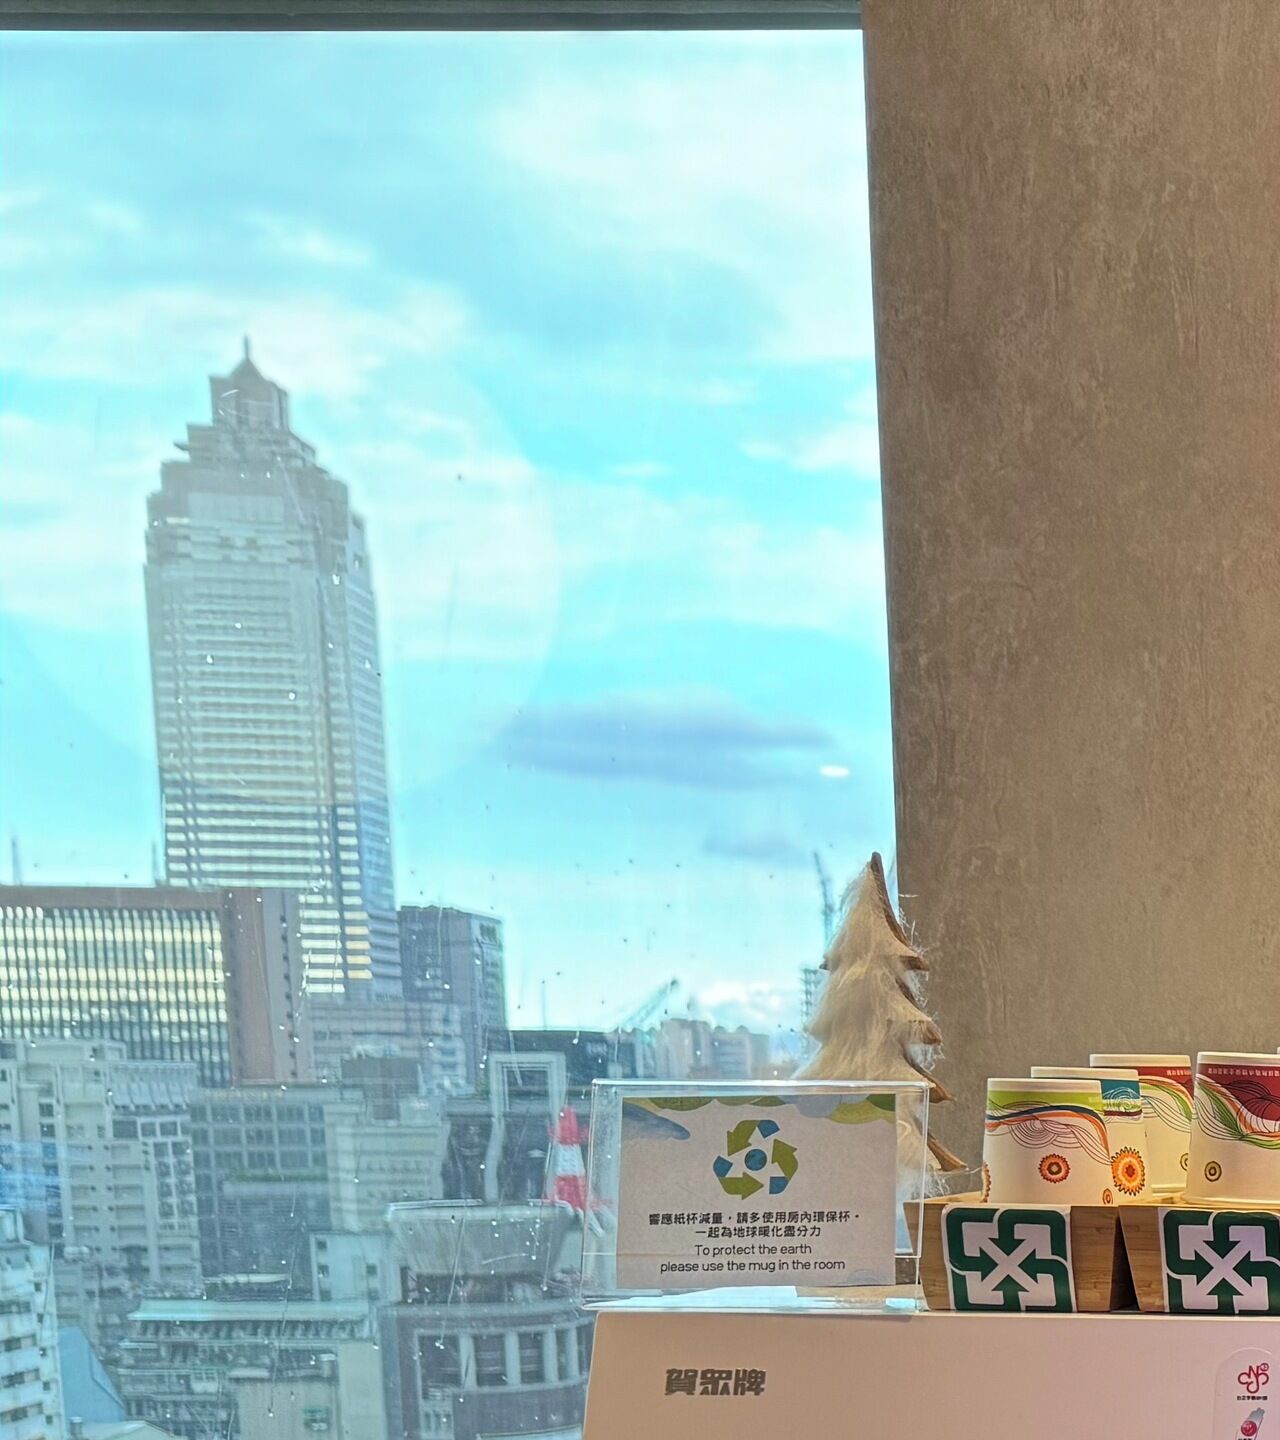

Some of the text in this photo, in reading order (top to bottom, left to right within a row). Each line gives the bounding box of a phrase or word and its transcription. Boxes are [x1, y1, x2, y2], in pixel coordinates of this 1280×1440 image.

[695, 1226, 821, 1238] 一起為地球暖化盡分力
[695, 1243, 812, 1257] To protect the earth
[660, 1259, 846, 1274] please use the mug in the room
